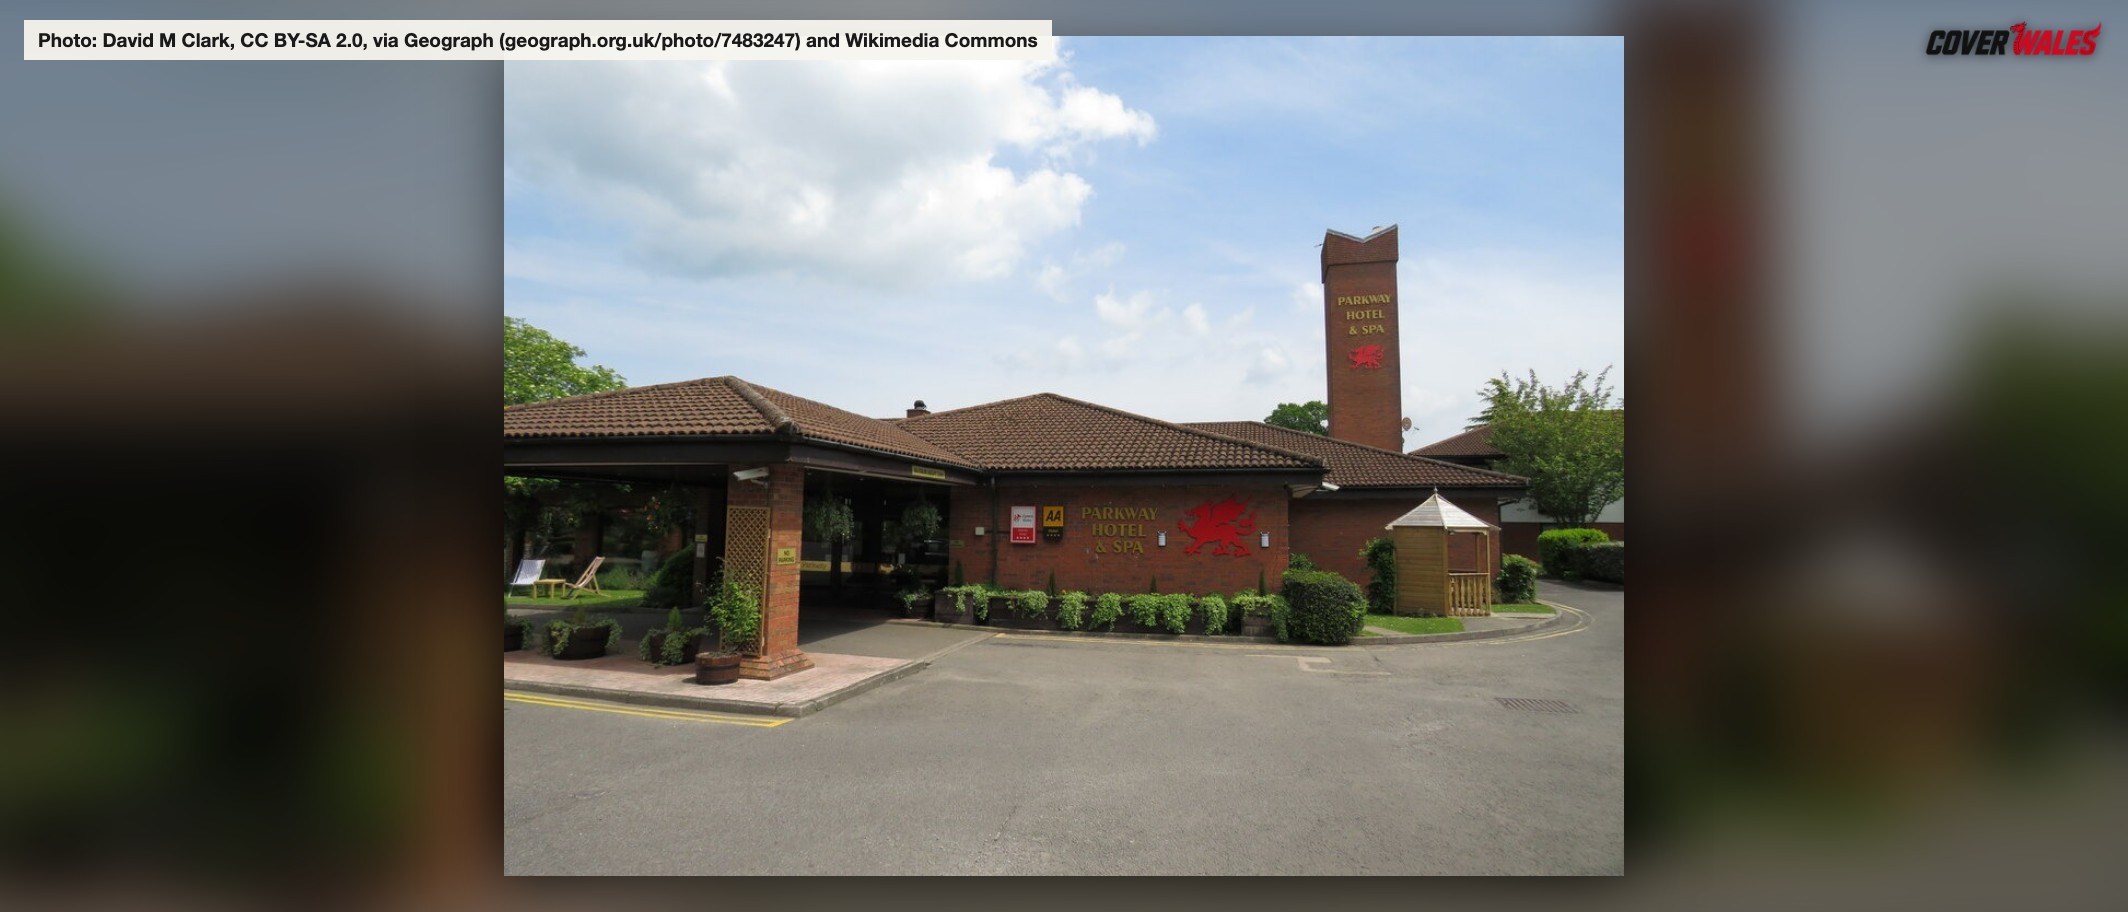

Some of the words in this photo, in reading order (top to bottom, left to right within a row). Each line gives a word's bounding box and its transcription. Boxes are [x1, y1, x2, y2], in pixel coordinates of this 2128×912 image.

[1337, 294, 1392, 306] PARKWAY
[1346, 309, 1385, 320] HOTEL
[1348, 325, 1358, 336] &
[1362, 324, 1385, 335] SPA
[1045, 510, 1062, 522] AA
[1081, 506, 1158, 520] PARKWAY
[1091, 523, 1147, 537] HOTEL
[1095, 540, 1107, 553] &
[1112, 540, 1144, 554] SPA
